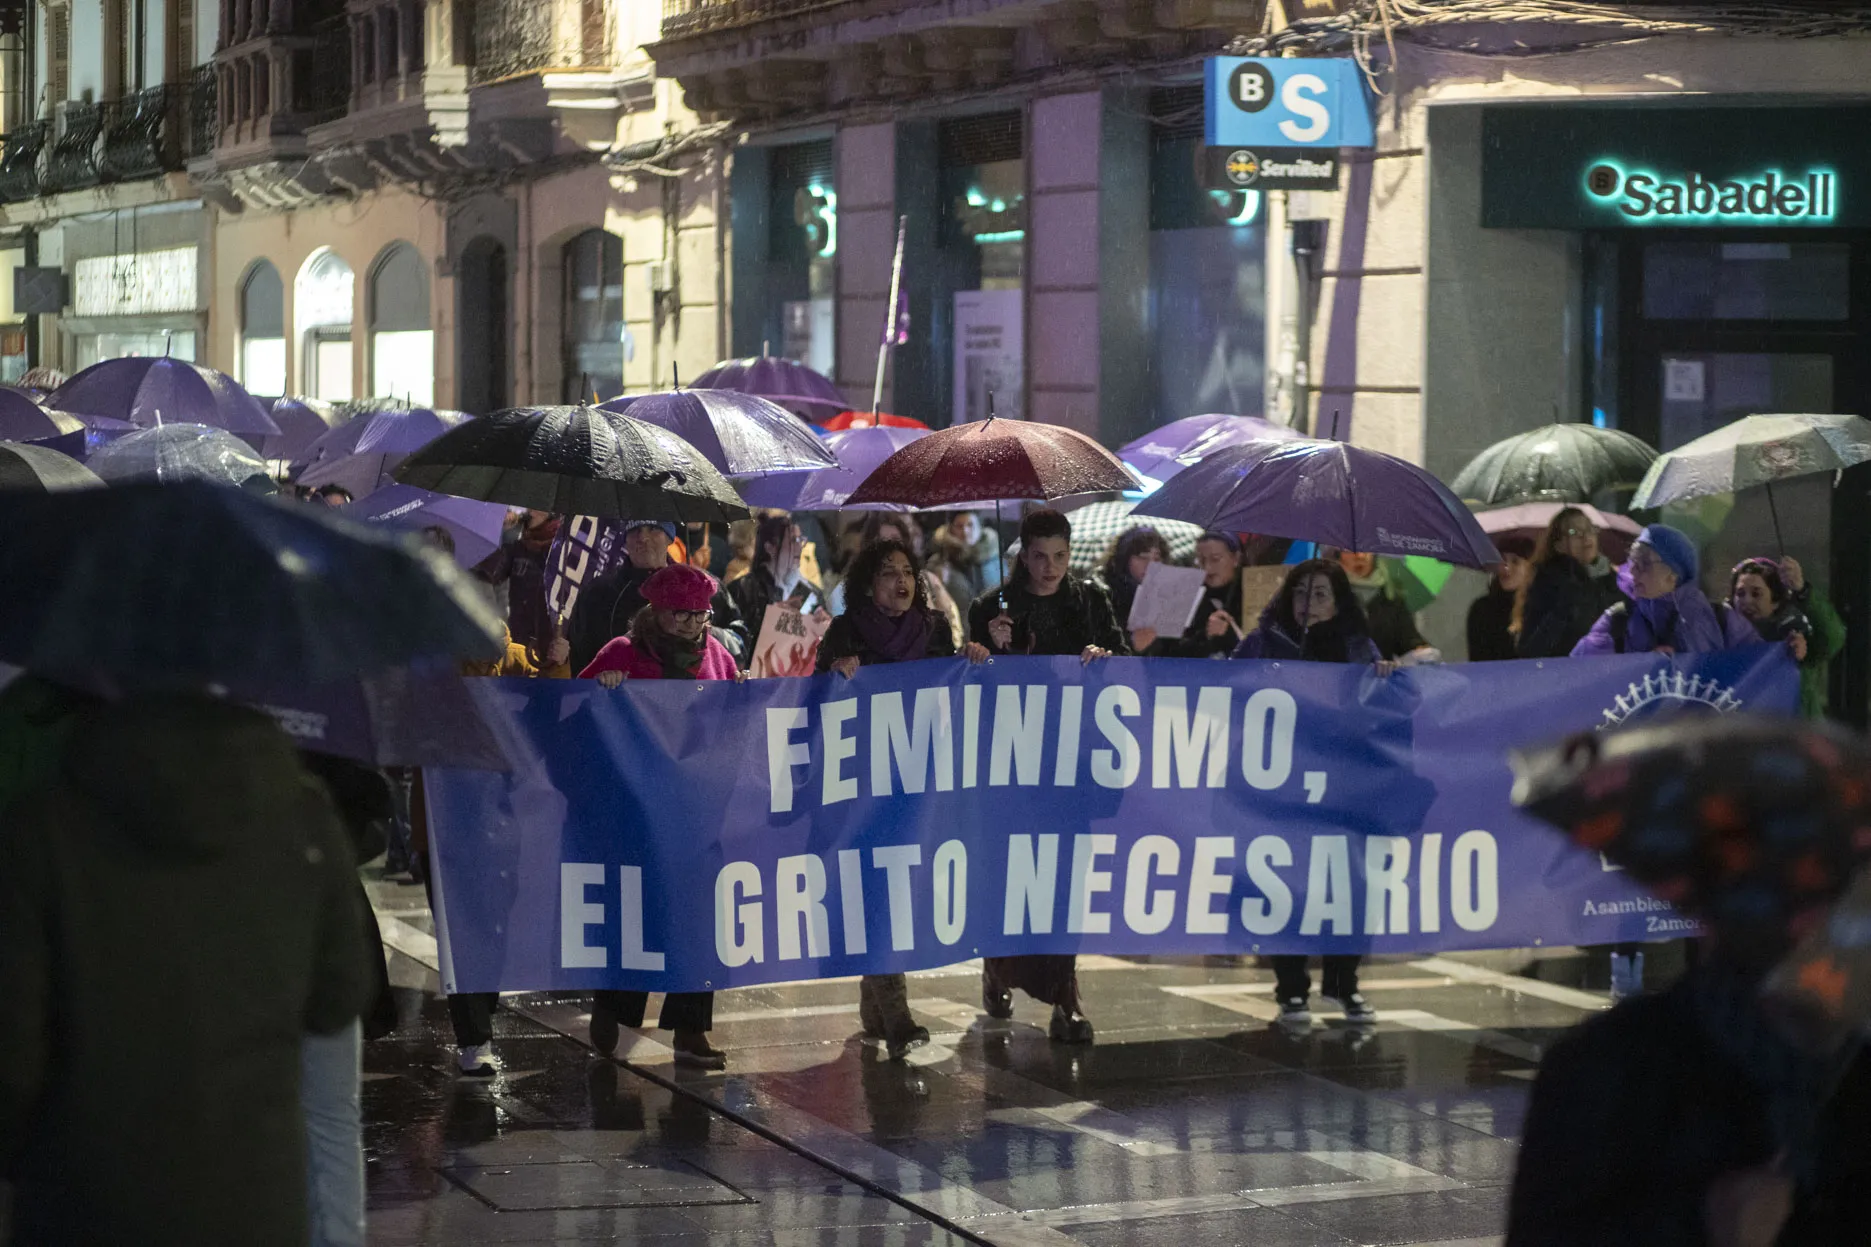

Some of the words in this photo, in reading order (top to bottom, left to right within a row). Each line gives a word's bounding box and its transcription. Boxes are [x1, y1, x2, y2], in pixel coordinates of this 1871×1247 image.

[1240, 73, 1264, 101] B
[1278, 74, 1330, 142] S
[1260, 158, 1333, 178] ServiRed
[1620, 170, 1833, 217] Sabadell
[766, 684, 1327, 813] FEMINISMO,
[561, 862, 665, 971] EL
[715, 839, 967, 967] GRITO
[1003, 830, 1498, 935] NECESARIO
[1583, 897, 1672, 916] Asamblea
